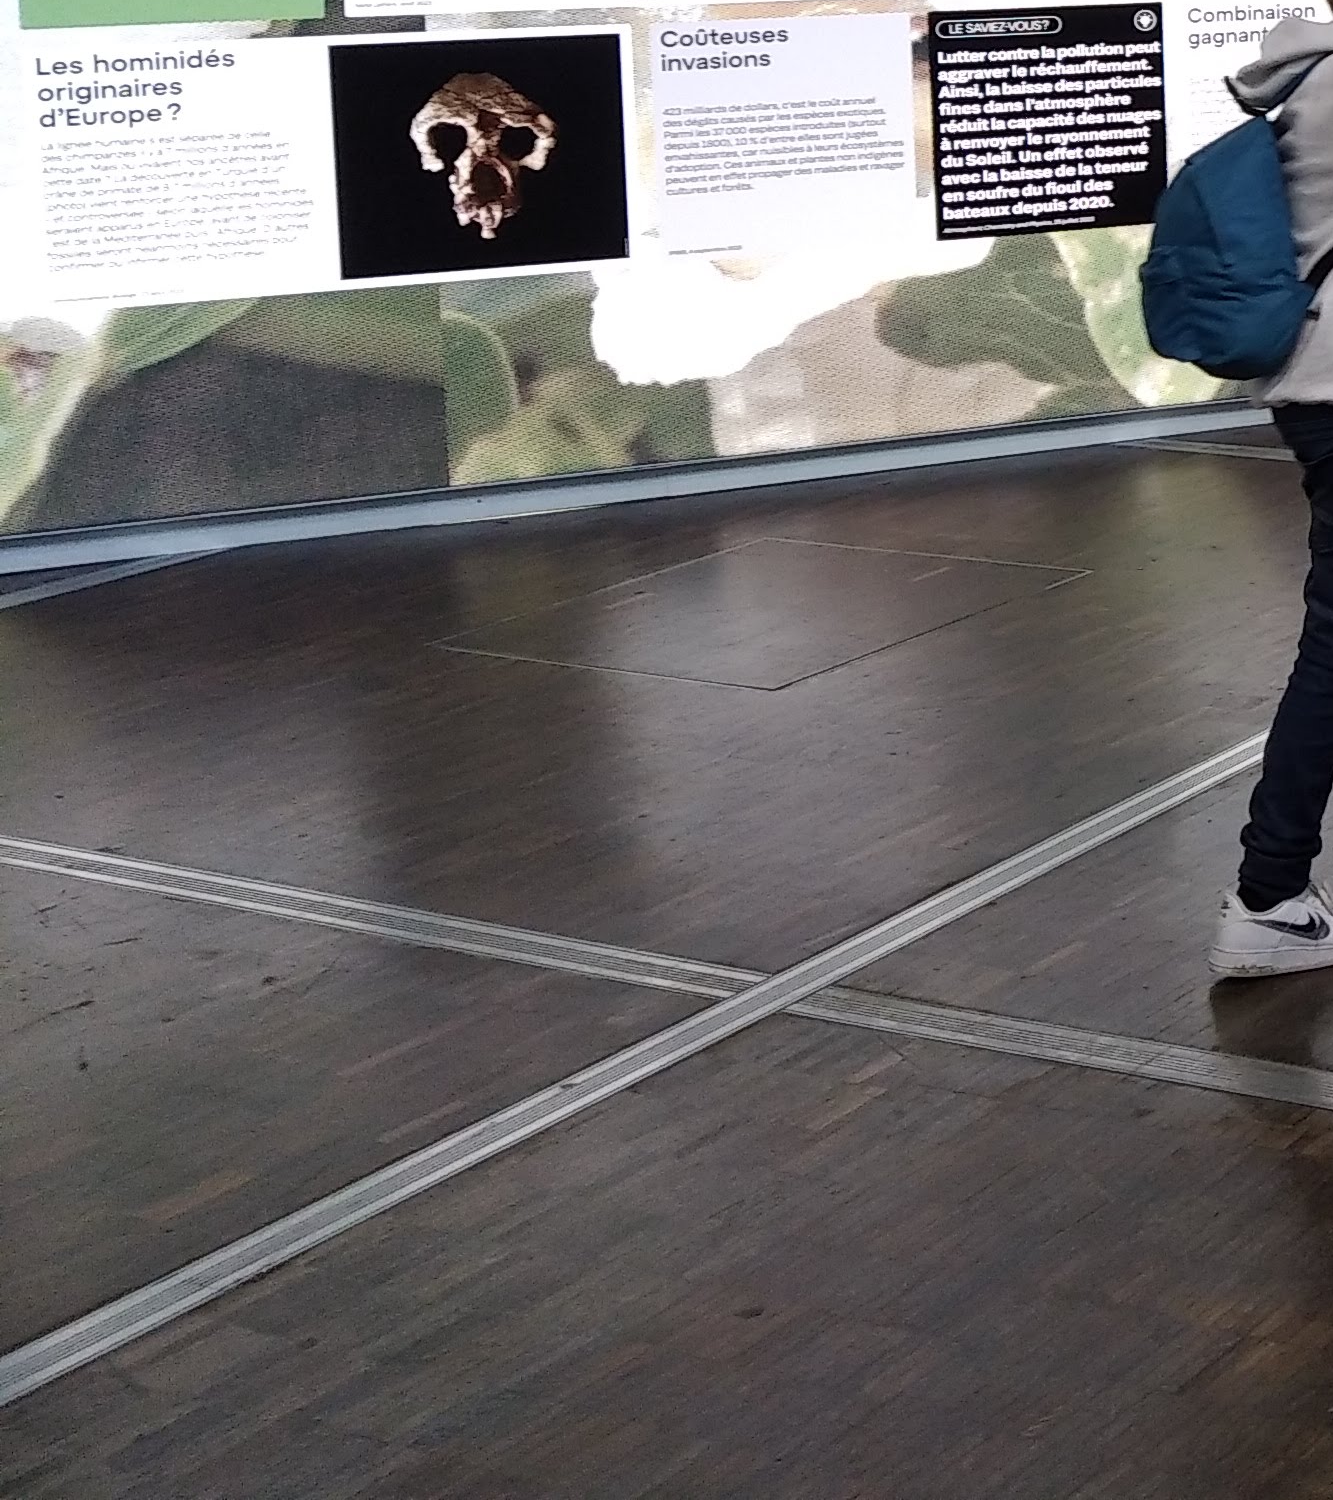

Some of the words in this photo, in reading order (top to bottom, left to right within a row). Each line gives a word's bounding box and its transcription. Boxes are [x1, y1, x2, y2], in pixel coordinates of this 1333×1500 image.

[1188, 5, 1315, 23] Combinaison
[660, 28, 788, 48] Coûteuses
[949, 24, 964, 34] LE
[36, 58, 83, 76] Les
[93, 49, 235, 73] hominidés
[661, 51, 771, 72] invasions
[937, 49, 986, 64] Lutter
[988, 47, 1039, 61] contre
[1041, 45, 1054, 58] la
[1057, 41, 1123, 60] pollution
[1126, 41, 1161, 57] peut
[937, 67, 1009, 84] aggraver
[1012, 64, 1026, 78] le
[1030, 57, 1152, 76] réchauffement.
[38, 78, 183, 105] originaires
[938, 100, 980, 116] fines
[983, 98, 1023, 113] dans
[1026, 92, 1131, 113] l'atmosphère
[939, 117, 989, 133] réduit
[991, 116, 1005, 130] la
[1007, 112, 1074, 132] capacité
[1076, 110, 1104, 124] des
[1107, 109, 1162, 126] nuages
[939, 137, 951, 150] à
[953, 135, 1025, 152] renvoyer
[1027, 132, 1042, 145] le
[1044, 125, 1150, 146] rayonnement
